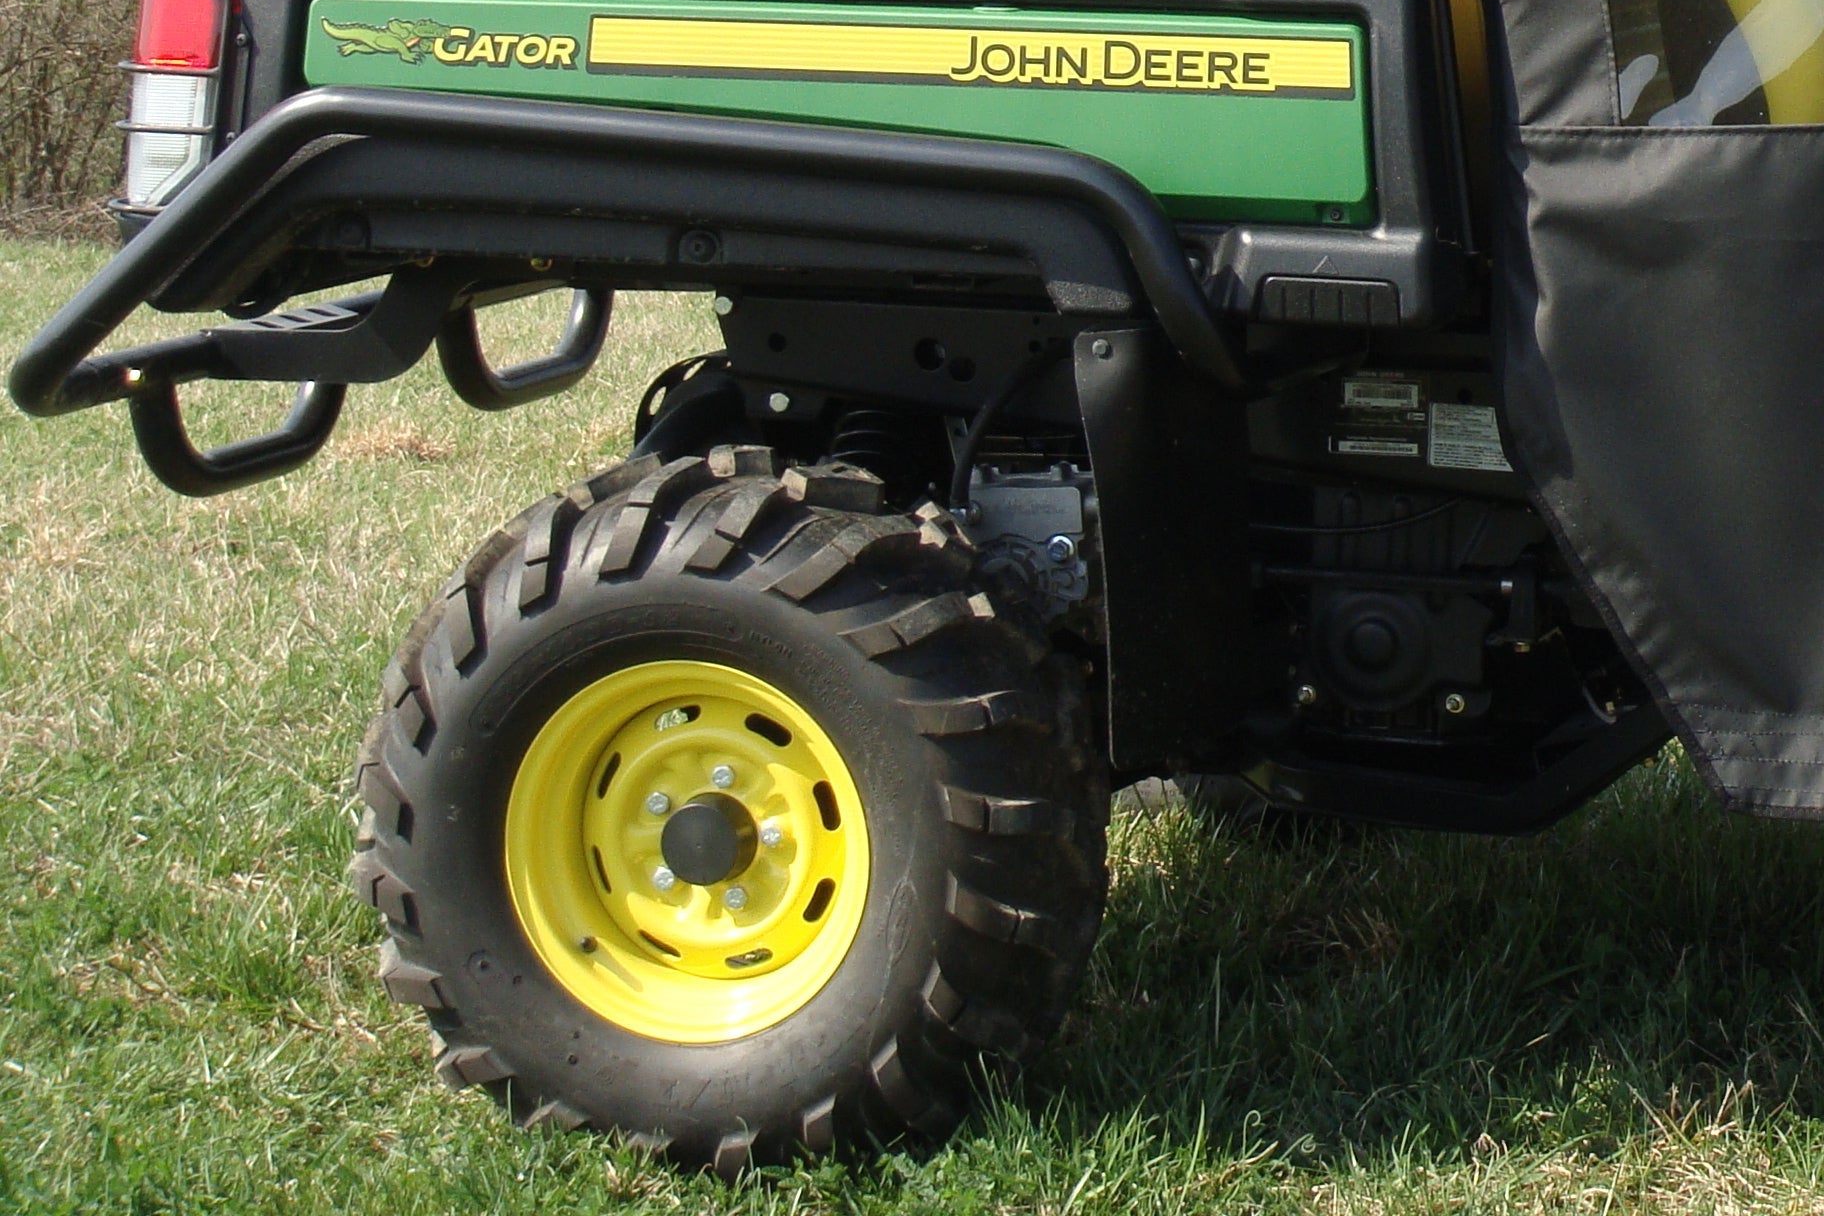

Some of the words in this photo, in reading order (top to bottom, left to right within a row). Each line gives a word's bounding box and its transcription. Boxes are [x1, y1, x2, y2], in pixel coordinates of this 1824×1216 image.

[432, 26, 577, 69] GATOR
[951, 35, 1088, 81] JOHN
[1103, 39, 1271, 86] DEERE
